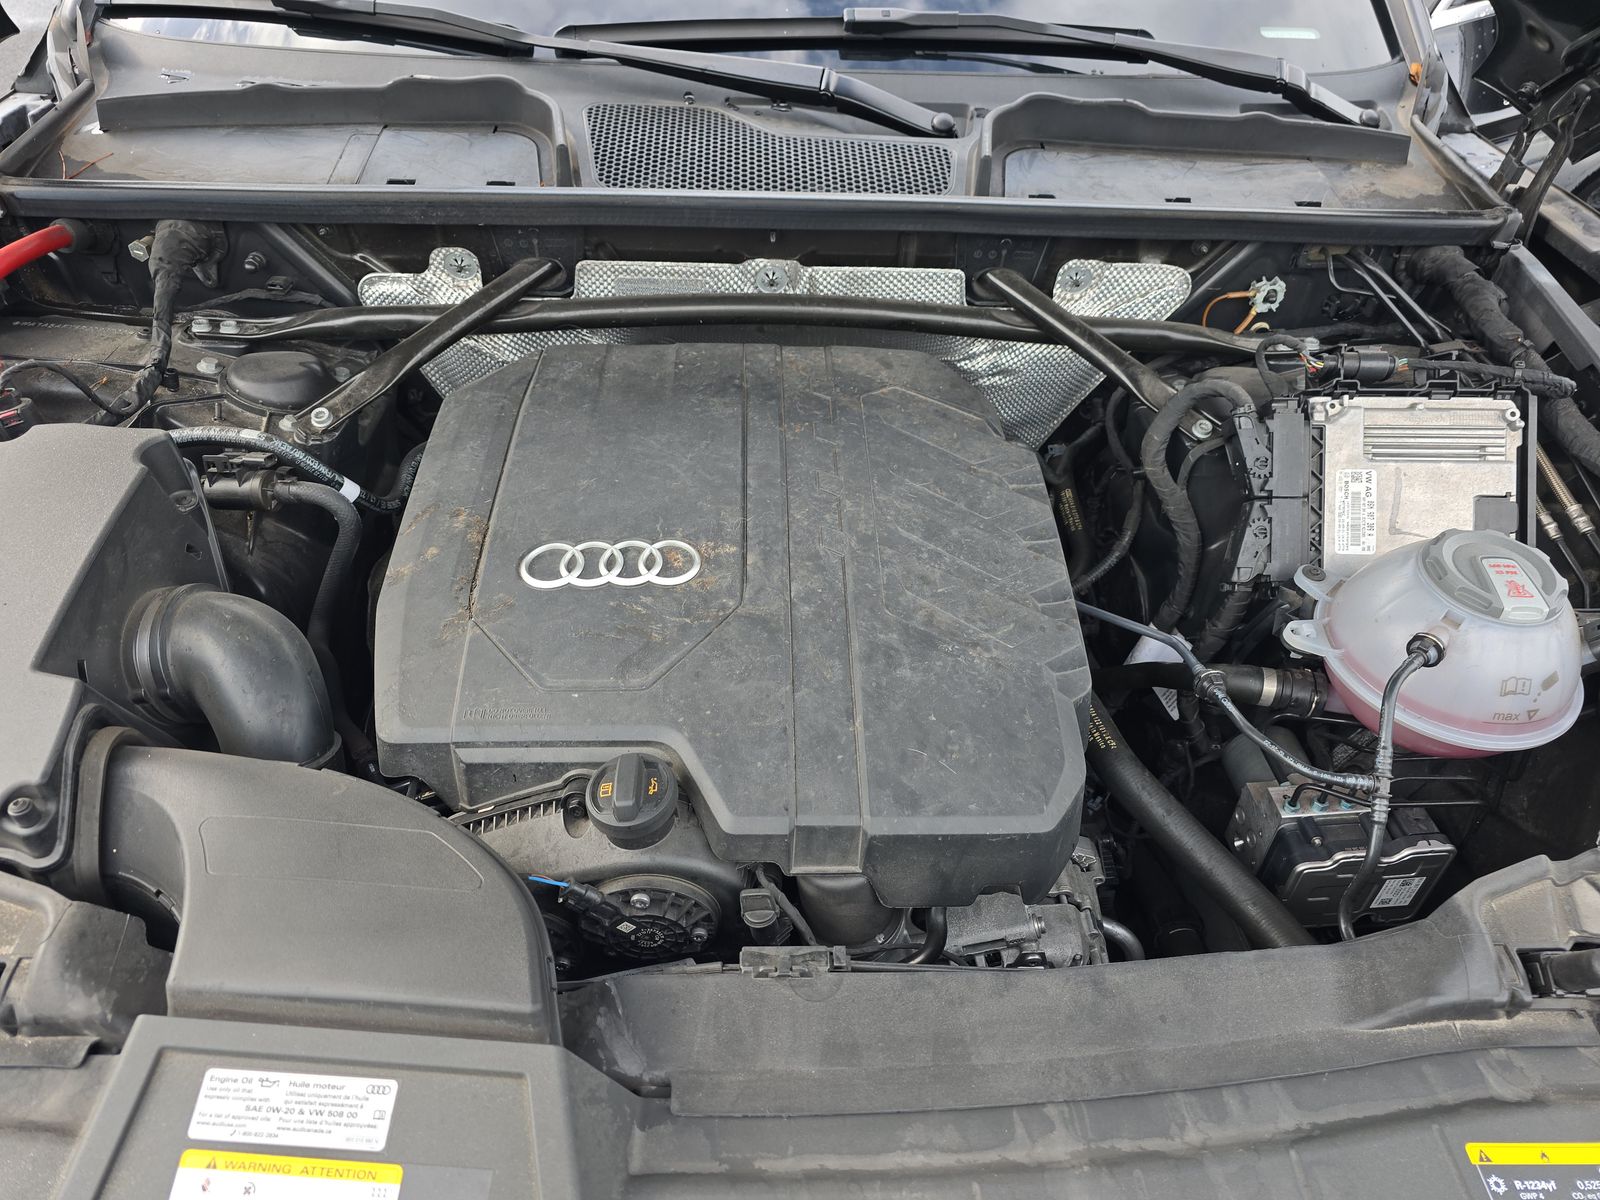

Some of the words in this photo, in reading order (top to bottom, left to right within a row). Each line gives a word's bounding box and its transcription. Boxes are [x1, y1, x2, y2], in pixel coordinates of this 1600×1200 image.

[1366, 471, 1372, 484] VW
[1365, 486, 1372, 498] AG
[1492, 711, 1521, 721] max
[210, 1075, 238, 1084] Engine
[266, 1106, 295, 1114] 0W-20
[224, 1160, 292, 1175] WARNING
[300, 1164, 378, 1180] ATTENTION
[1513, 1180, 1557, 1192] R-1234yf
